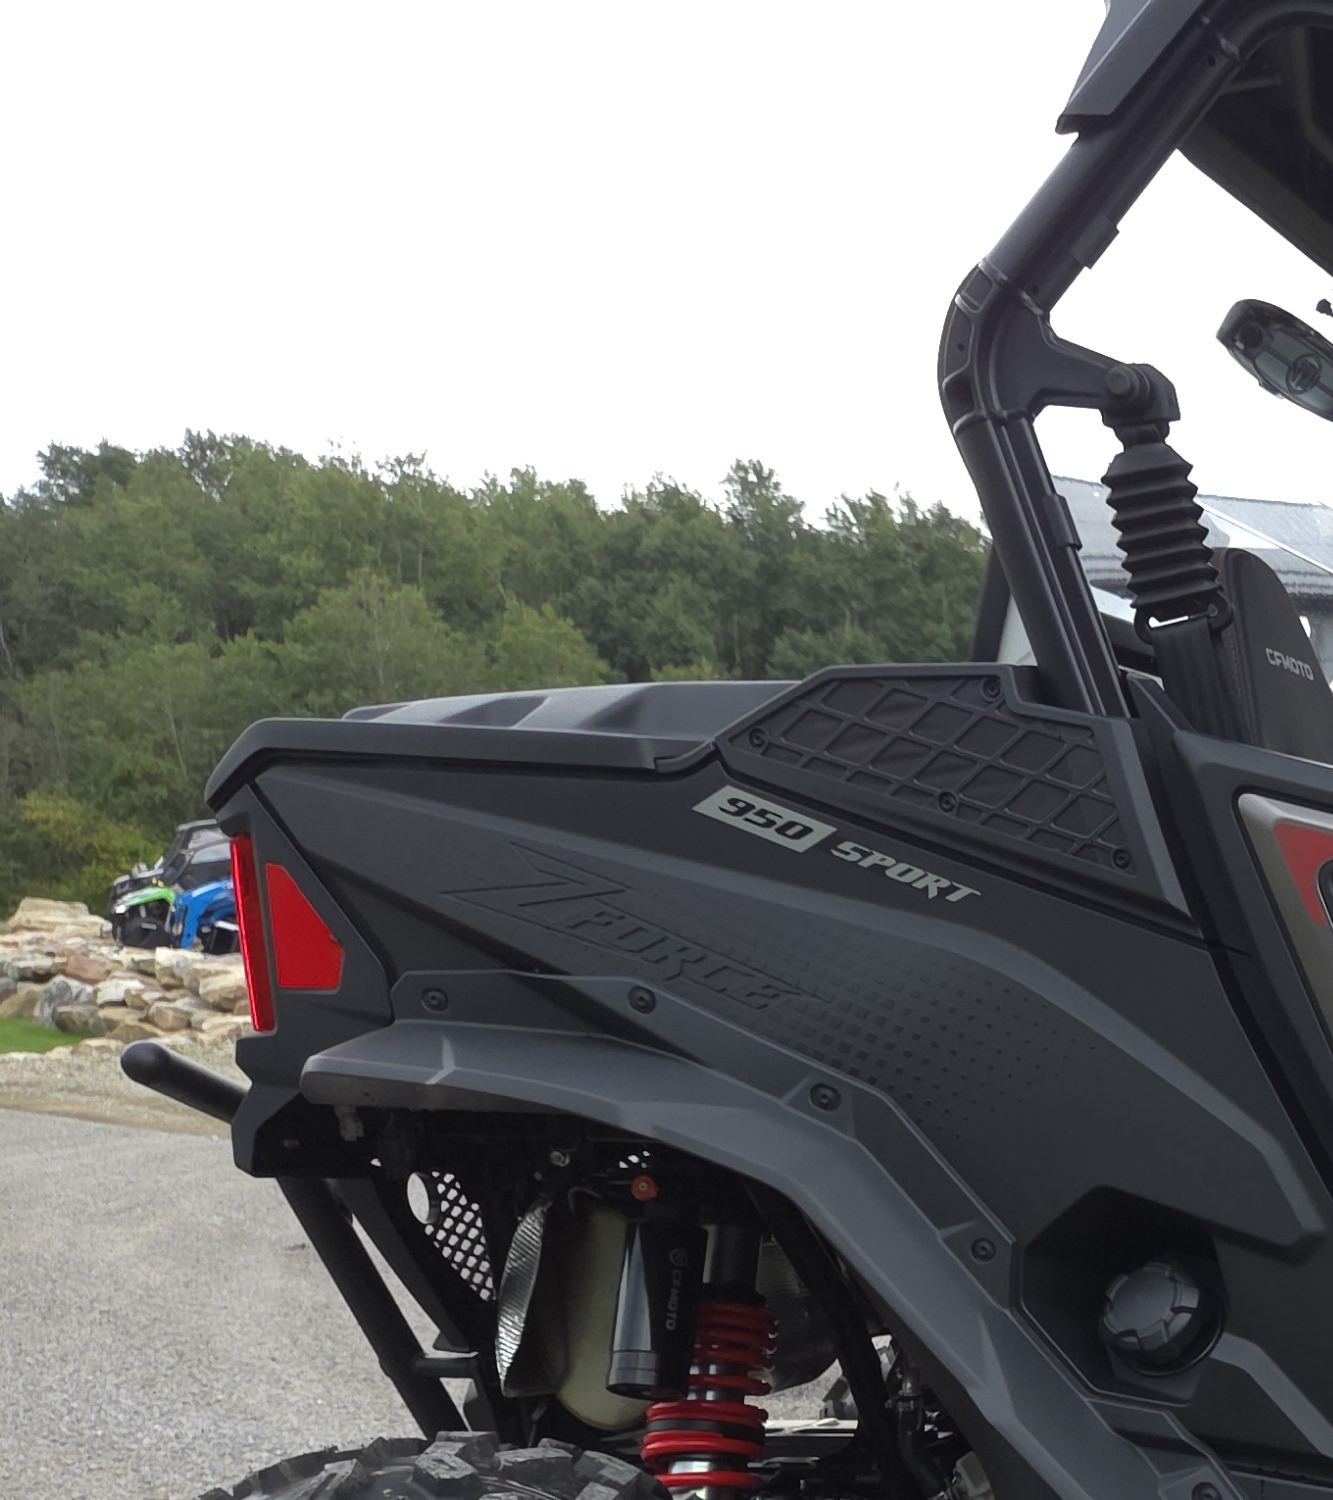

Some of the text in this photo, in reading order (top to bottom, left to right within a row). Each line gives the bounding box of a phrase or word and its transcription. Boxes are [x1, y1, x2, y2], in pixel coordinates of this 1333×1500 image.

[1264, 647, 1314, 681] CFMOTO
[718, 797, 982, 902] 950 SPORT
[665, 1268, 683, 1331] CFMOTO
